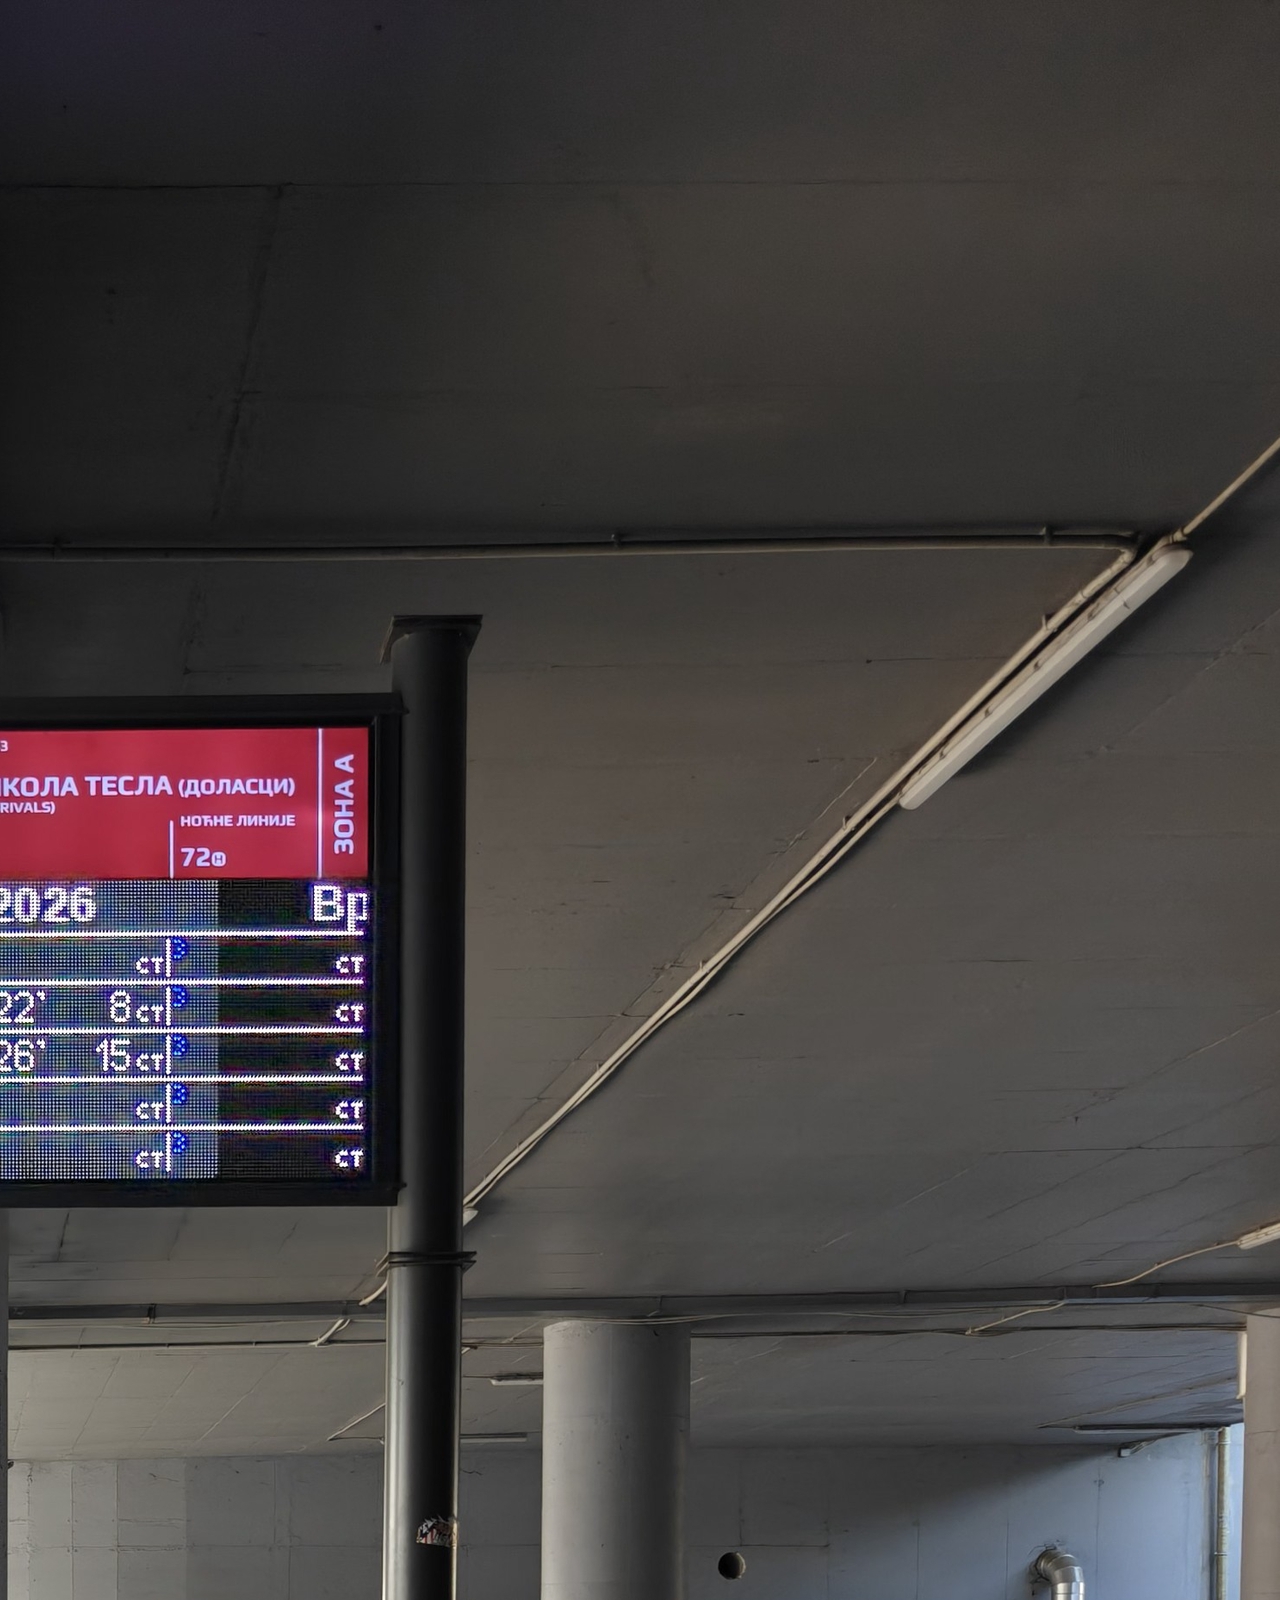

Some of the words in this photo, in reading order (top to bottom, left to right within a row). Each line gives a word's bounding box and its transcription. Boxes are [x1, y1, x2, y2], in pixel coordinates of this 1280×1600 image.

[84, 775, 173, 797] ТЕСЛА
[178, 777, 296, 799] (ДОЛАСЦИ)
[180, 815, 234, 827] НОЋНЕ
[236, 814, 296, 827] ЛИНИЈЕ
[334, 779, 355, 855] ЗОНА
[313, 885, 368, 934] Вр
[135, 957, 164, 975] ст
[335, 955, 364, 974] ст
[335, 1003, 364, 1023] ст
[335, 1052, 364, 1071] ст
[135, 1101, 164, 1121] ст
[335, 1100, 364, 1119] ст
[135, 1150, 164, 1169] ст
[335, 1149, 364, 1168] ст
